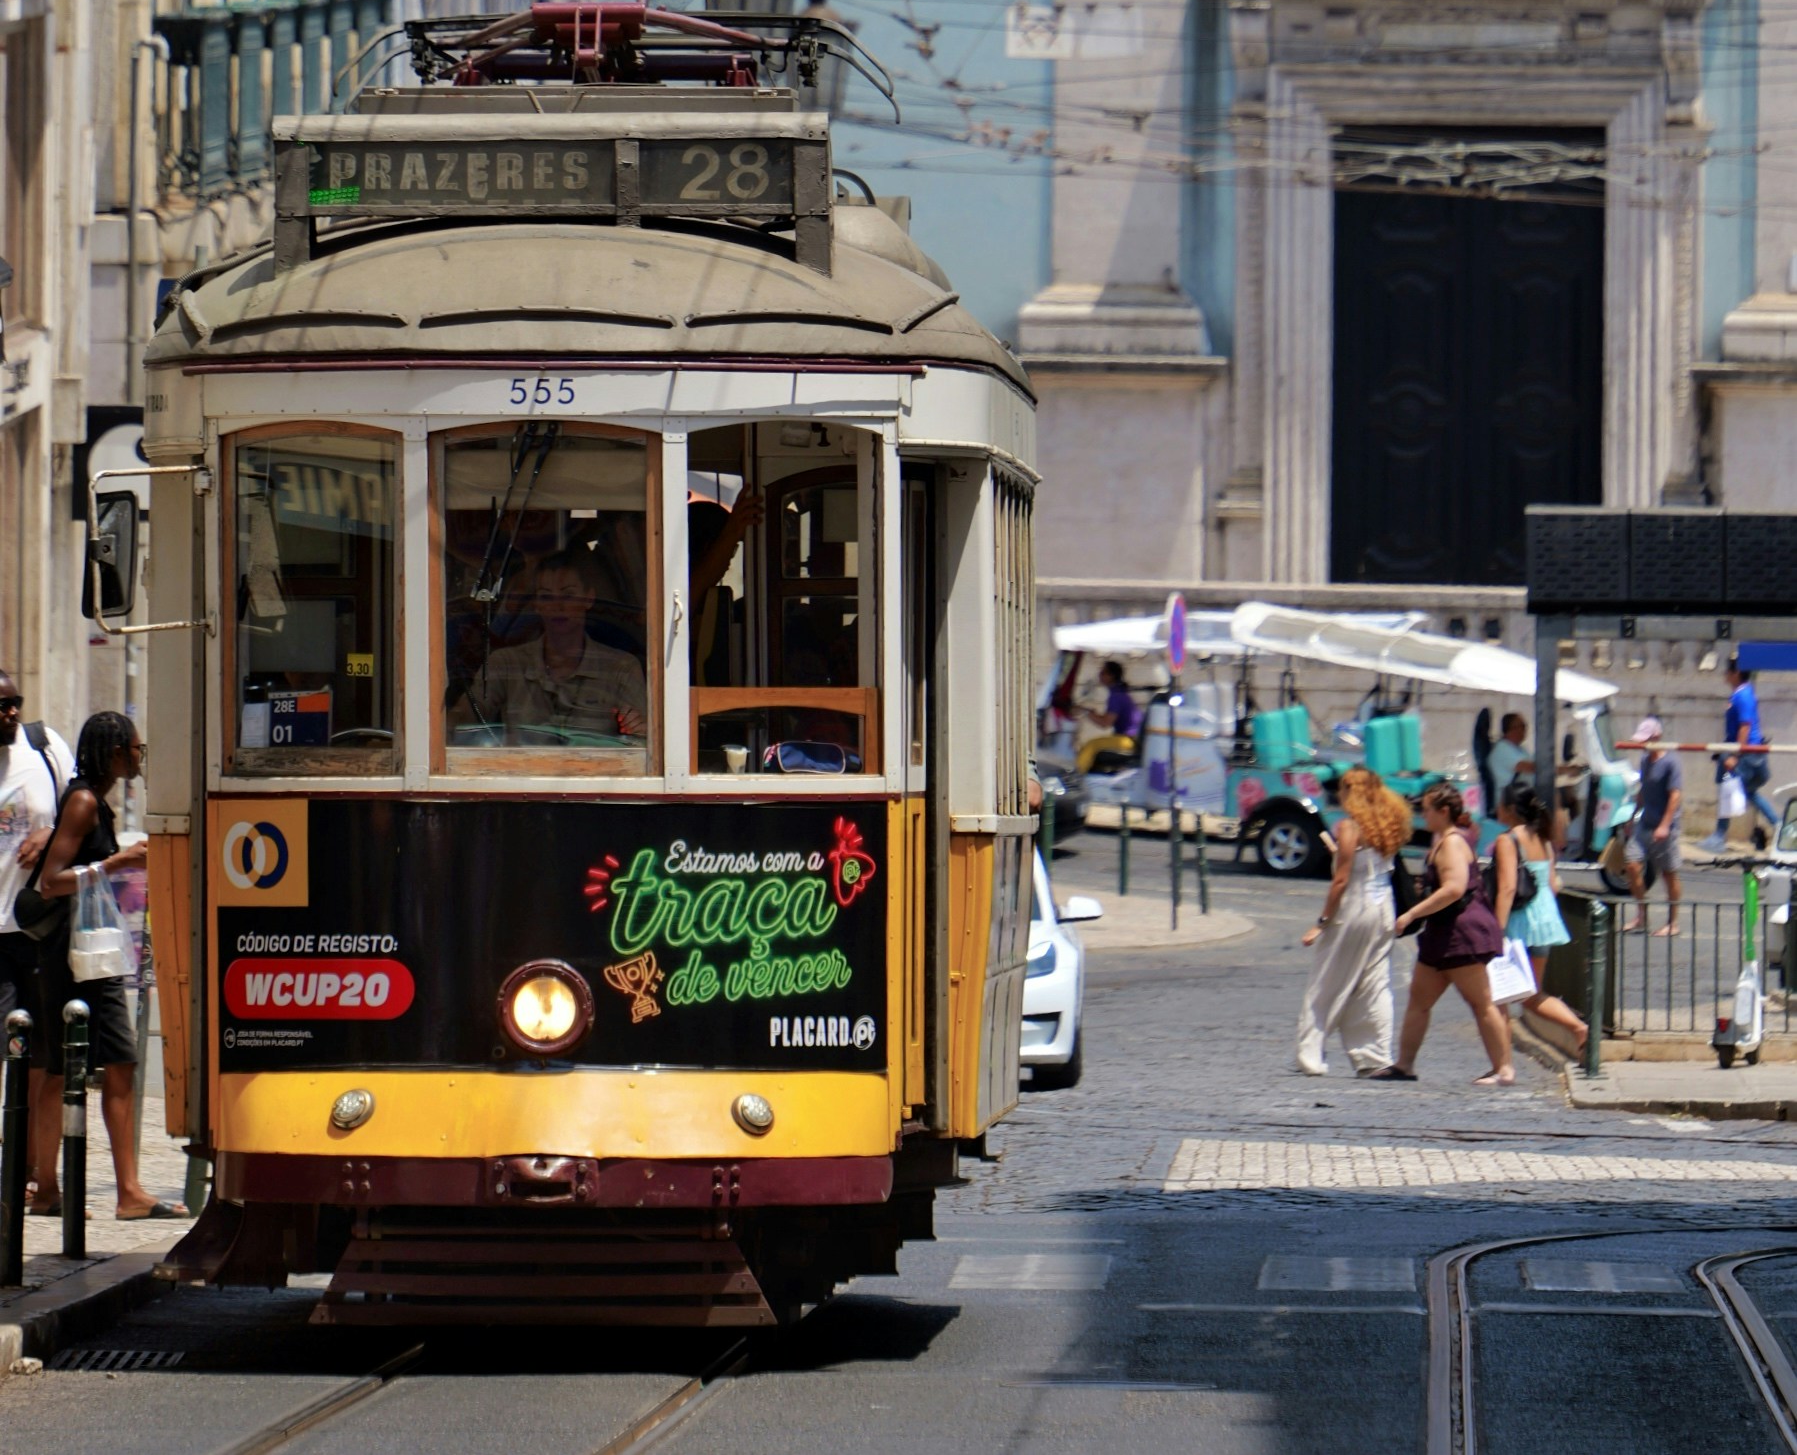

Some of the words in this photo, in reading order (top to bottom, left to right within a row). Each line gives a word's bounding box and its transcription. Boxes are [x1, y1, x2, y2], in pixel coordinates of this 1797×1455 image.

[329, 151, 588, 199] PRAZERES
[679, 144, 769, 200] 28
[510, 378, 575, 405] 555
[273, 700, 296, 713] 28E
[272, 724, 293, 744] 01
[664, 839, 760, 874] Estamos
[762, 851, 805, 873] com
[807, 851, 825, 871] a
[610, 849, 838, 960] traça
[237, 931, 291, 953] CÓDIGO
[293, 934, 315, 953] DE
[318, 934, 398, 954] REGISTO:
[245, 972, 390, 1008] WCUP20
[666, 949, 720, 1006] de
[724, 949, 852, 1001] vencer
